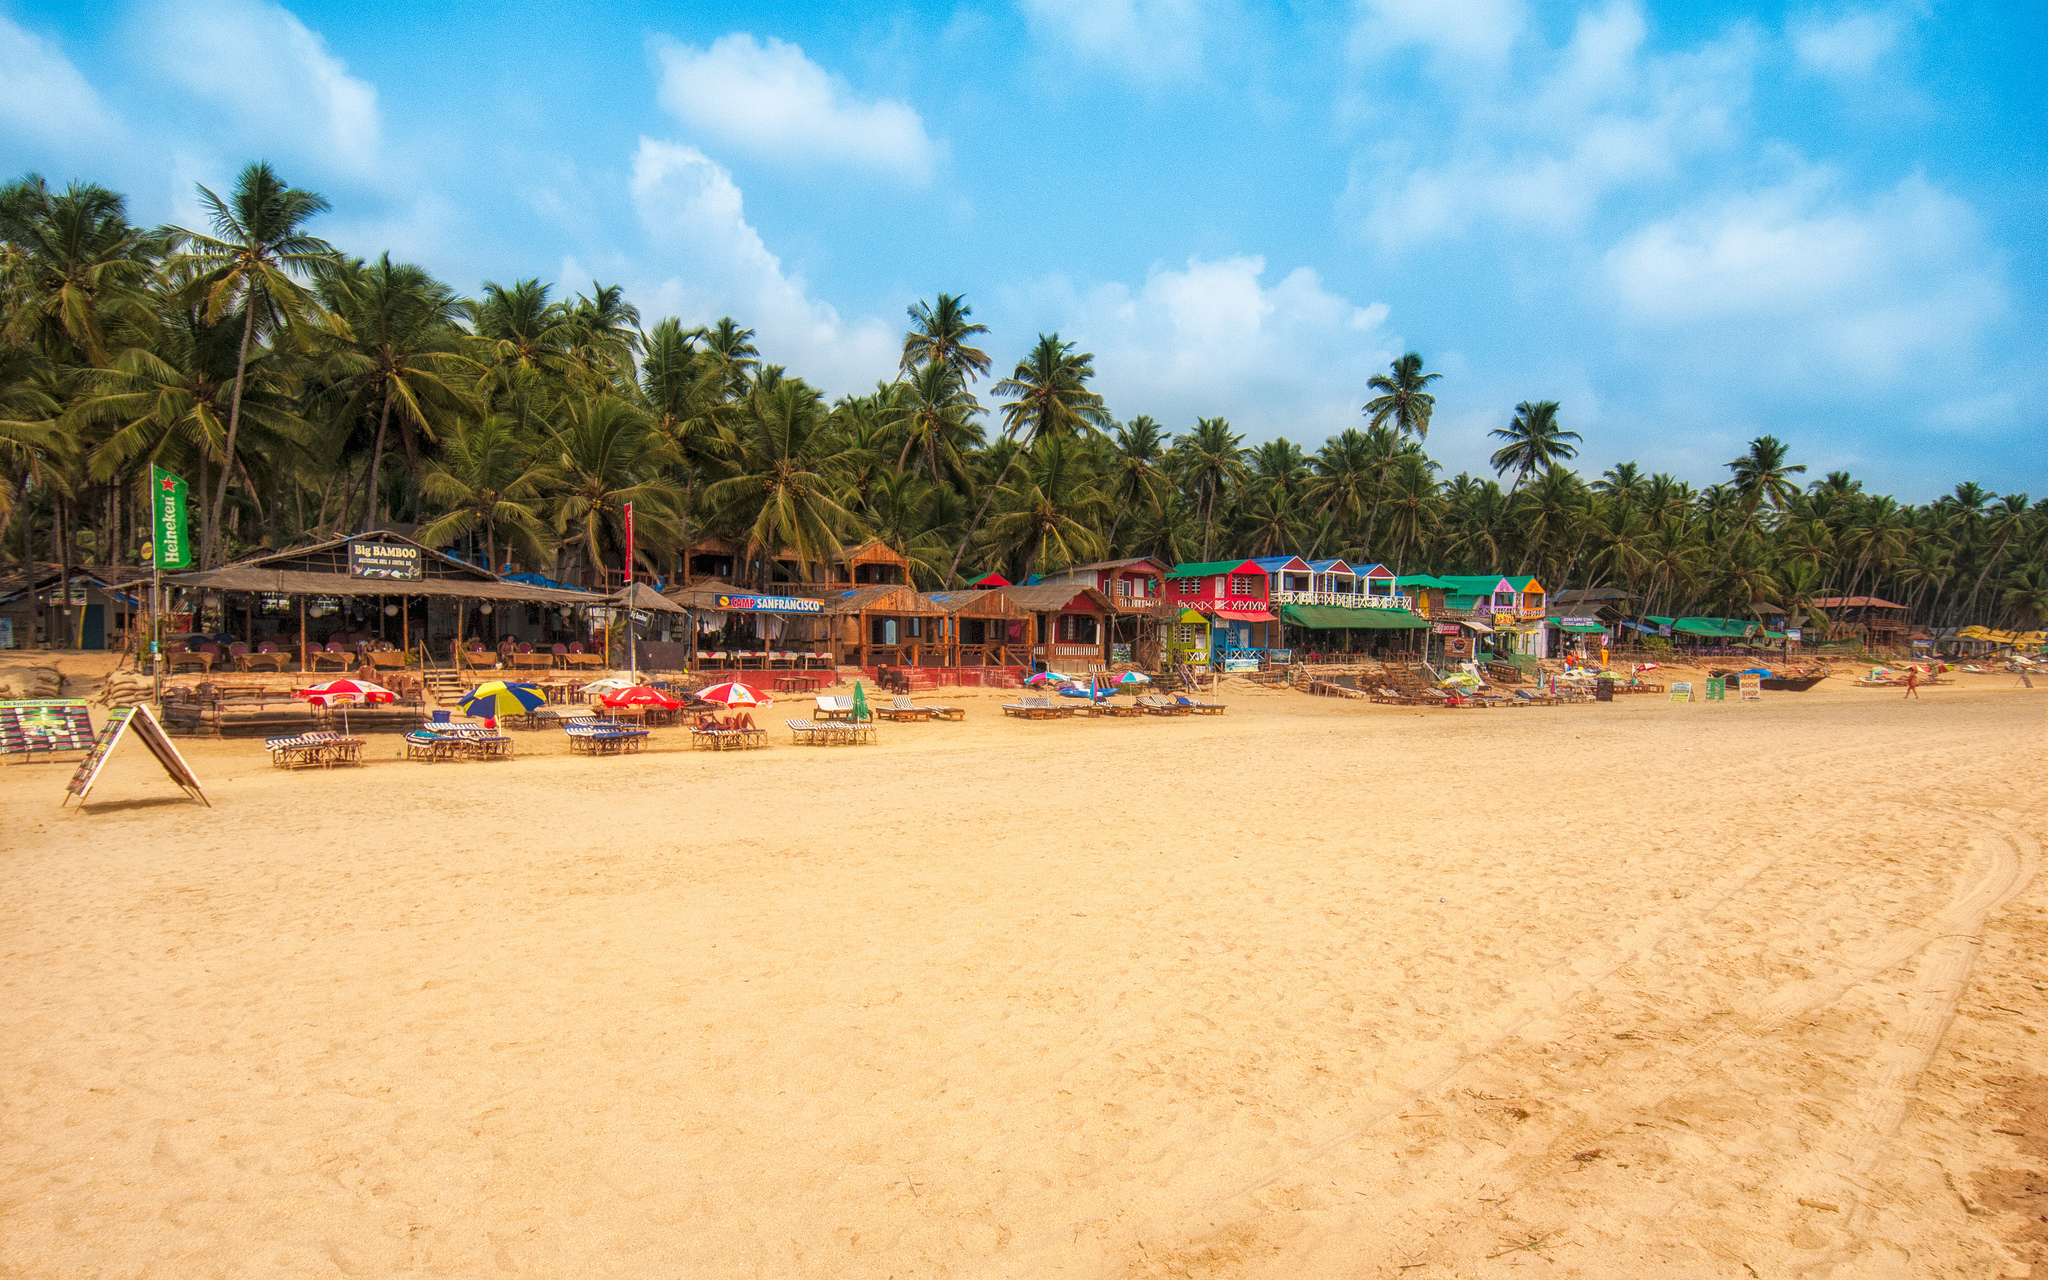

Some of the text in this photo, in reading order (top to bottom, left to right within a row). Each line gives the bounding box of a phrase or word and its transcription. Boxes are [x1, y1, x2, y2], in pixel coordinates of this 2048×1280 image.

[162, 496, 179, 563] Heineken
[354, 545, 416, 558] Big BAMBOO
[731, 597, 820, 611] CAMP SANFRANCISCO
